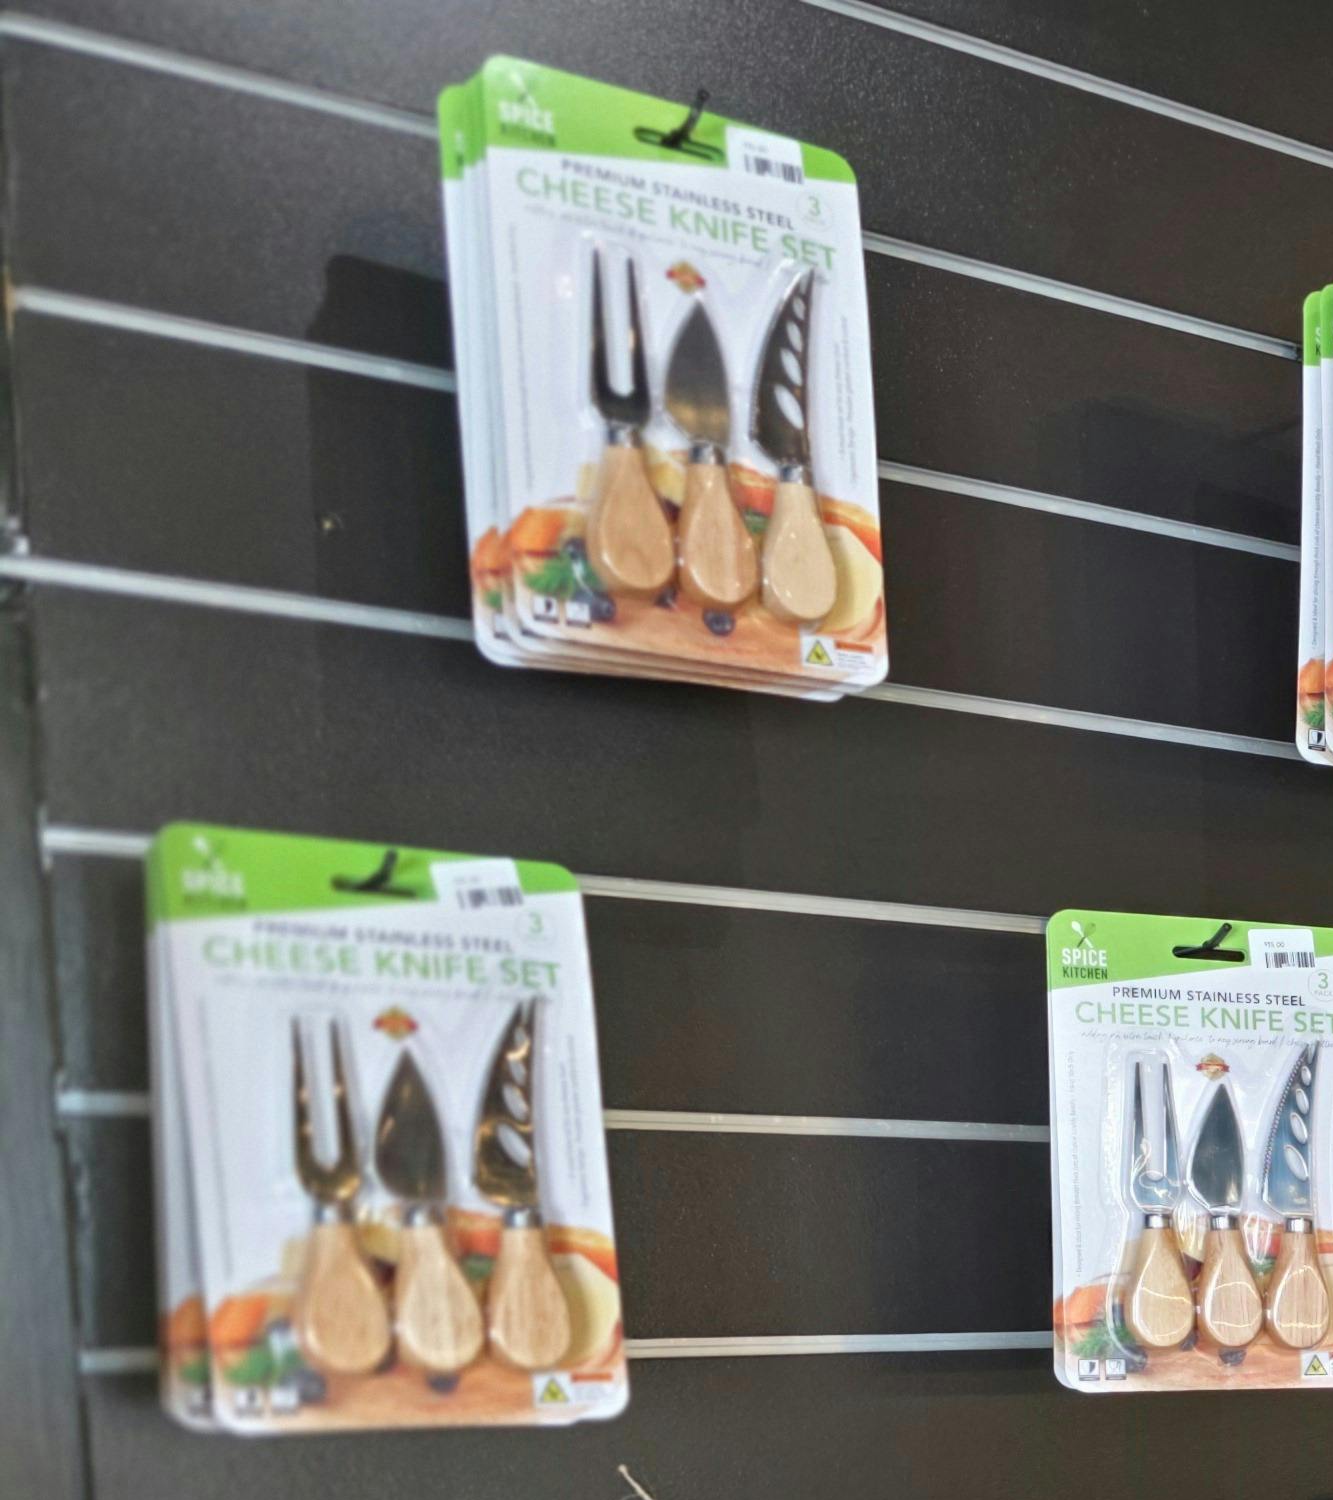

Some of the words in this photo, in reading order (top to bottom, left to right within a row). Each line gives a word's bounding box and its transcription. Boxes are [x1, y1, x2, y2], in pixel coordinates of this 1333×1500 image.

[561, 159, 645, 190] PREMIUM
[653, 178, 741, 217] STAINLESS
[746, 205, 794, 231] STEEL
[517, 167, 656, 225] CHEESE
[669, 205, 768, 253] KNIFE
[781, 232, 836, 270] SET
[253, 918, 348, 940] PREMIUM
[355, 927, 455, 950] STAINLESS
[462, 935, 512, 954] STEEL
[203, 937, 364, 977] CHEESE
[376, 948, 489, 984] KNIFE
[498, 960, 559, 989] SET
[1062, 948, 1107, 967] SPICE
[1062, 967, 1108, 980] KITCHEN
[1113, 986, 1182, 1001] PREMIUM
[1187, 990, 1260, 1005] STAINLESS
[1265, 994, 1306, 1007] STEEL
[1318, 972, 1328, 989] 3
[1075, 1001, 1189, 1028] CHEESE
[1201, 1007, 1283, 1033] KNIFE
